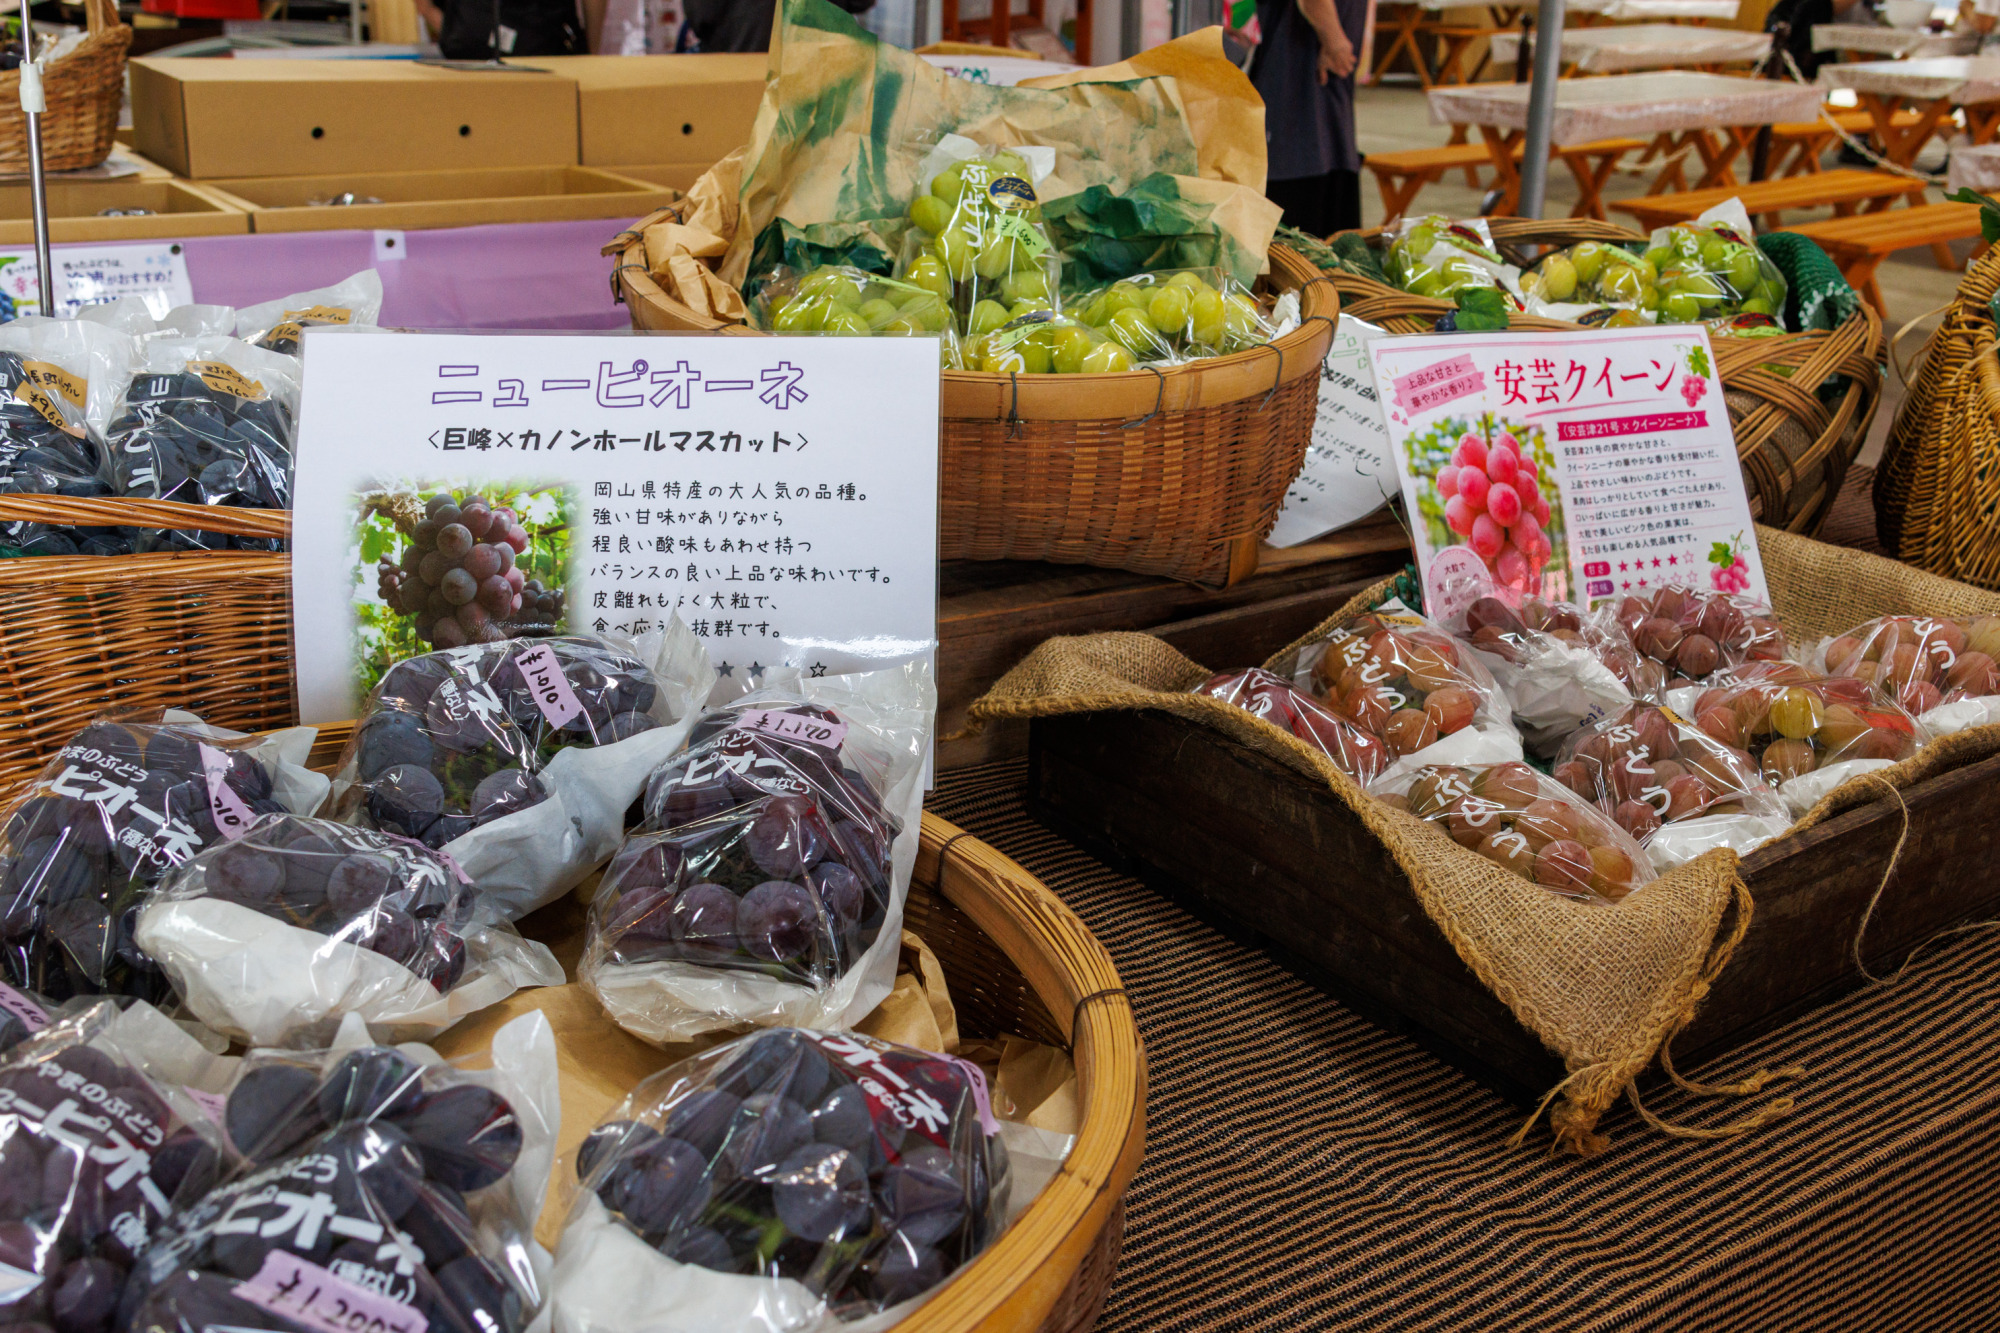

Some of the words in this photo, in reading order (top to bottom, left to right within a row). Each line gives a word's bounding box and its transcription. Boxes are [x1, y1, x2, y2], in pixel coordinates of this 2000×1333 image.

[432, 358, 809, 410] ニューピオーネ
[1408, 362, 1462, 390] 上品な甘さと
[1495, 357, 1676, 406] 安芸クイーン
[1571, 469, 1697, 490] 上品でやさしい味わいのぶどうです。
[594, 480, 867, 501] 岡山県特産の大人気の品種。
[592, 507, 783, 527] 強い甘味がありながら
[592, 534, 812, 555] 程良い酸味もあわせ持つ
[590, 562, 890, 584] バランスの良い上品な味わいです。
[1588, 564, 1605, 576] 甘さ
